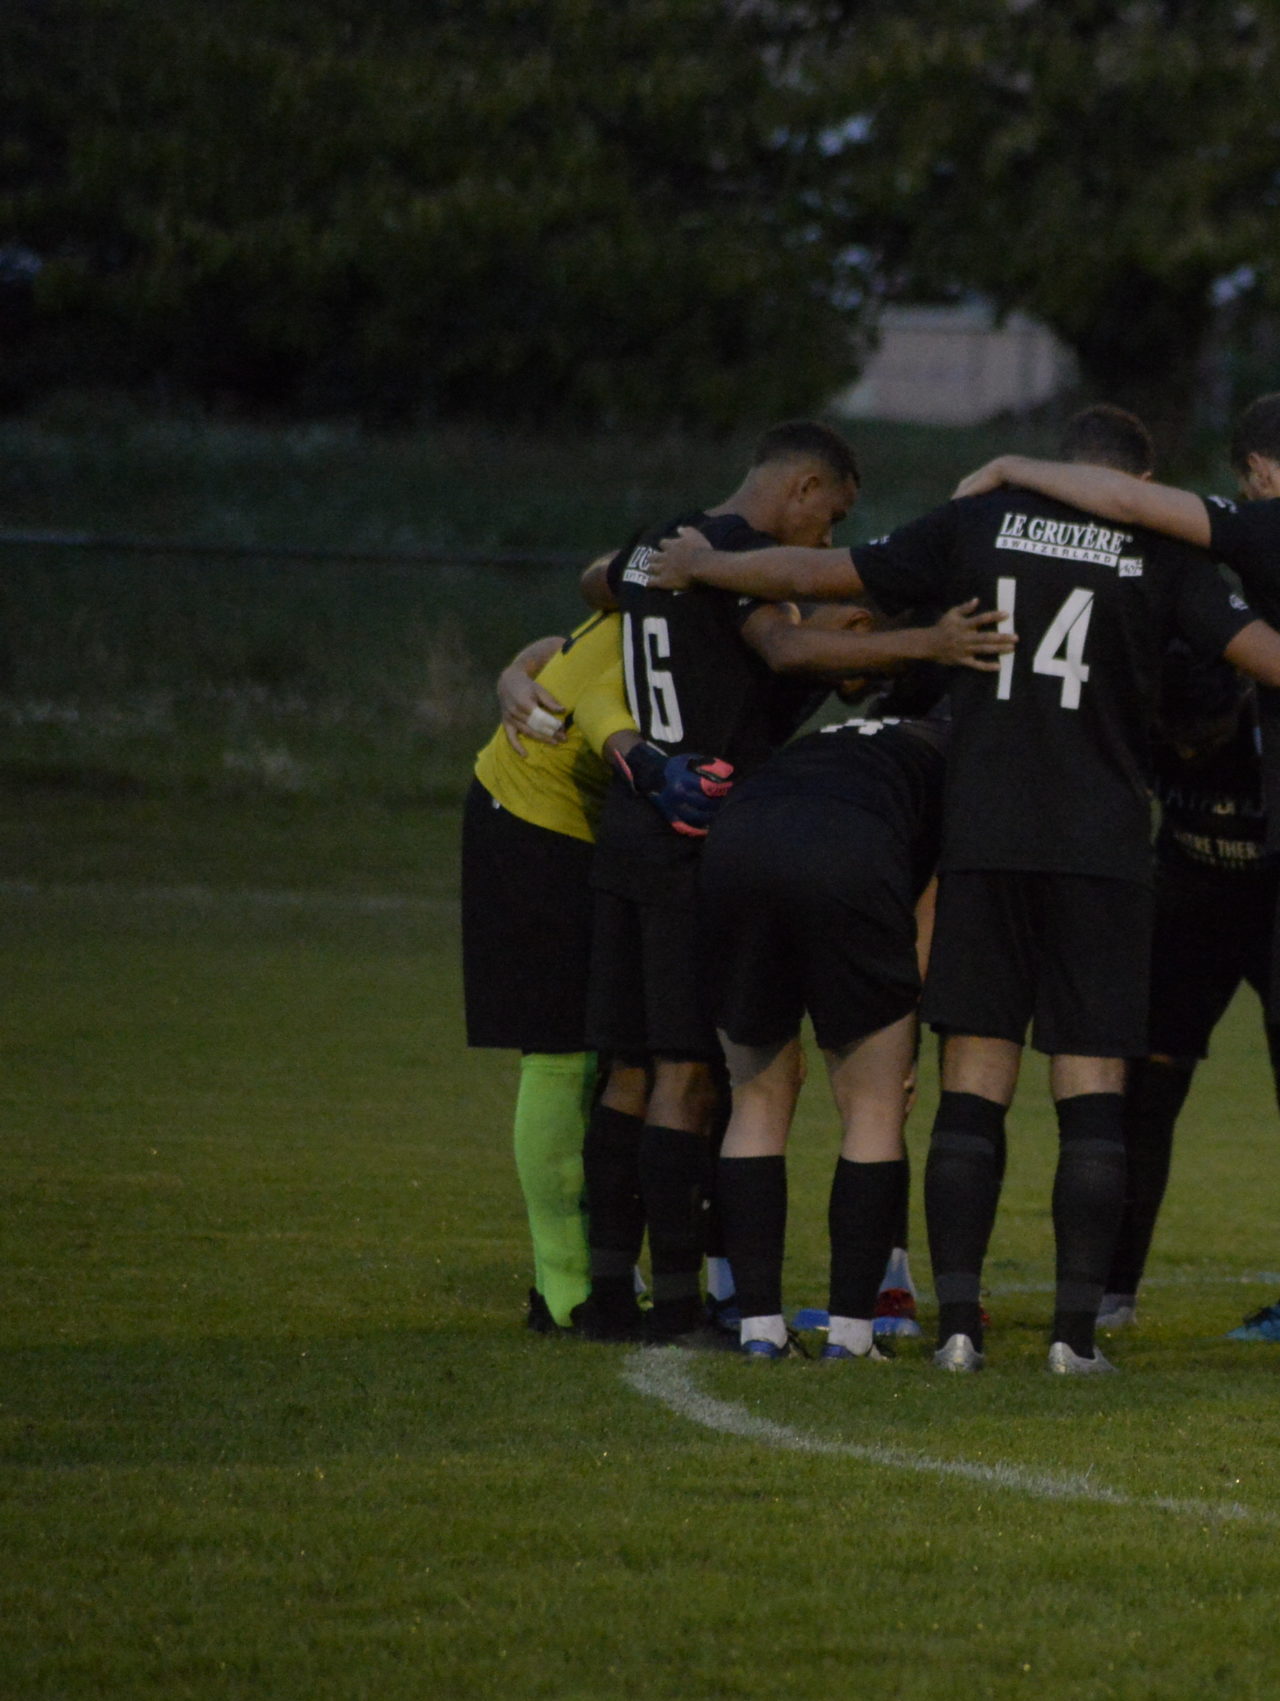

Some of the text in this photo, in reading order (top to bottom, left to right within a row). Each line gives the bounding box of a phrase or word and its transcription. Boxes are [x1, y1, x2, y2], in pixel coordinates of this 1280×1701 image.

[1000, 512, 1027, 537] LE
[1001, 539, 1112, 564] SWITZERLAND
[623, 612, 684, 744] 16
[995, 576, 1095, 710] 14
